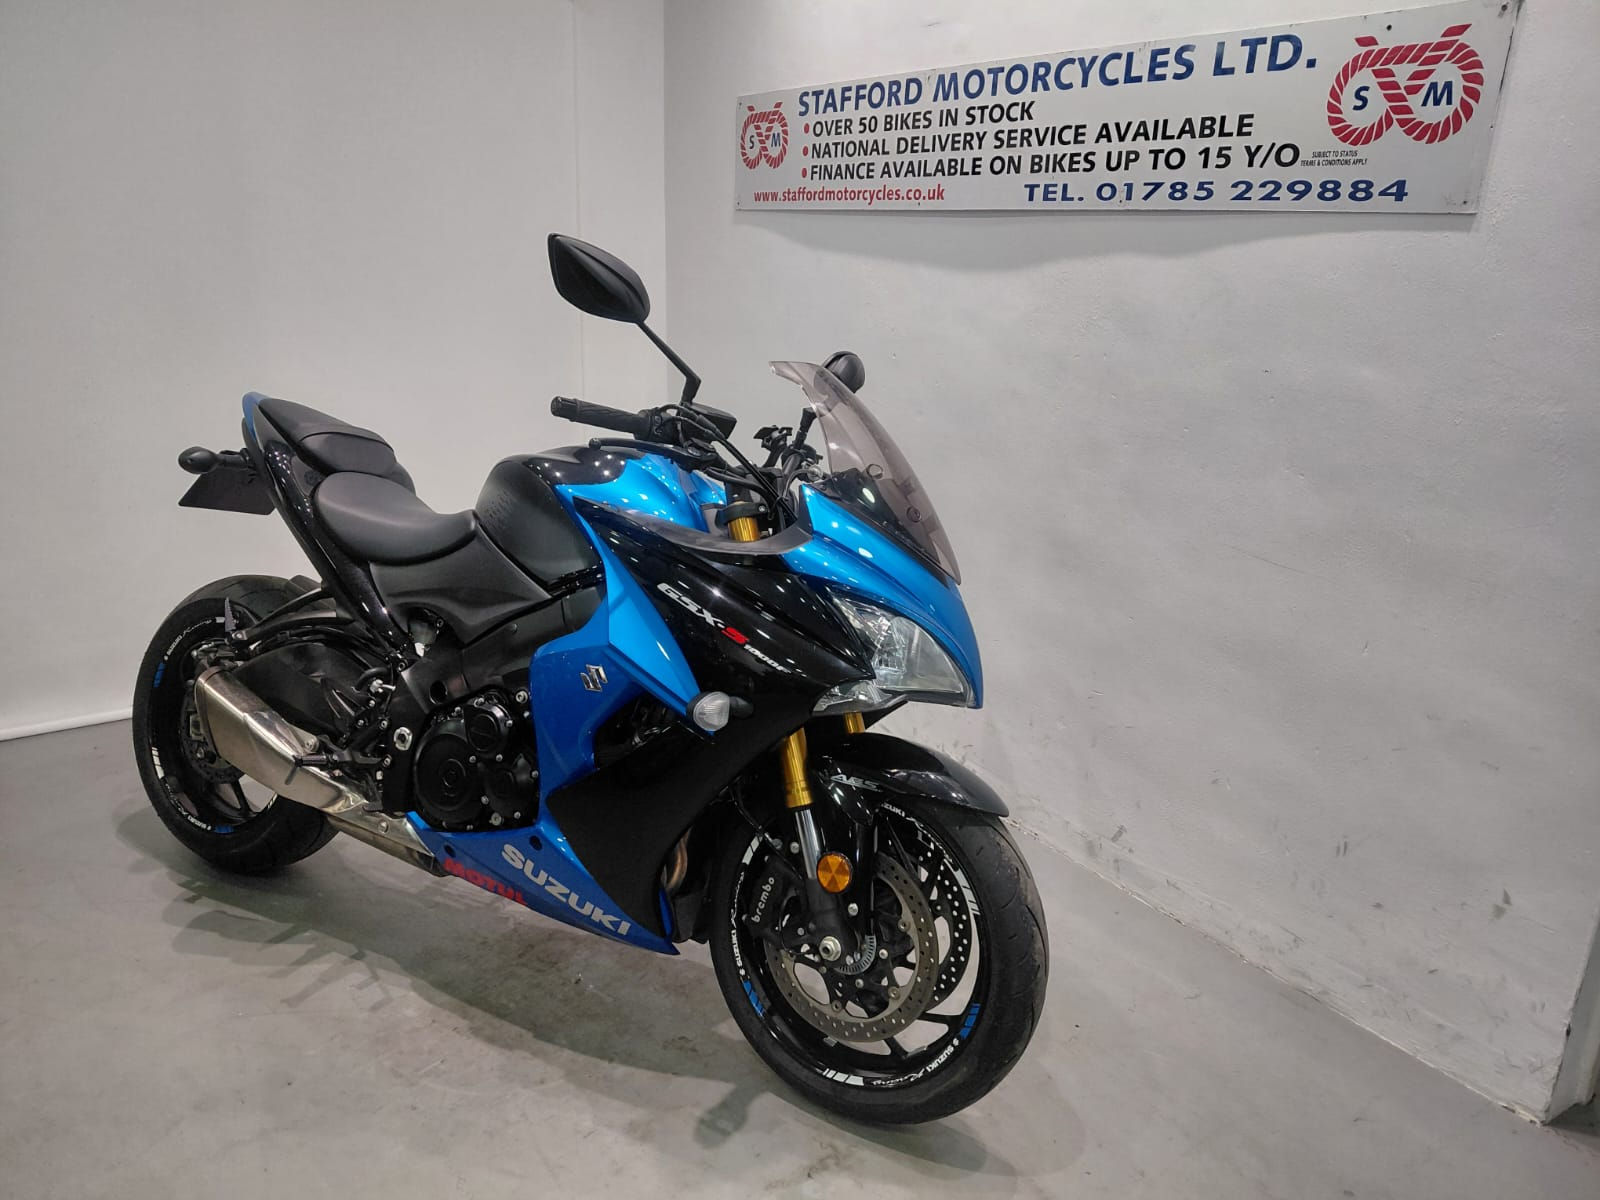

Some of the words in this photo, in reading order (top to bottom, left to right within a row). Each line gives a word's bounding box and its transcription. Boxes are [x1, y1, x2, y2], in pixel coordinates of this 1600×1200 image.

[798, 77, 923, 117] STAFFORD
[932, 44, 1196, 103] MOTORCYCLES
[1212, 33, 1317, 76] LTD.
[1352, 86, 1370, 111] S
[1421, 80, 1453, 107] M
[811, 138, 890, 159] NATIONAL
[896, 131, 987, 155] DELIVERY
[993, 124, 1087, 149] SERVICE
[1094, 113, 1255, 144] AVAILABLE
[812, 118, 853, 137] OVER
[858, 115, 878, 134] 50
[883, 110, 932, 132] BIKES
[938, 107, 959, 127] IN
[965, 100, 1035, 124] STOCK
[810, 162, 875, 181] FINANCE
[880, 157, 982, 179] AVAILABLE
[989, 155, 1021, 175] ON
[1029, 151, 1096, 174] BIKES
[1105, 150, 1140, 172] UP
[1148, 147, 1186, 170] TO
[1198, 146, 1232, 169] 15
[1245, 142, 1300, 168] Y/O
[1332, 150, 1339, 158] TO
[753, 183, 945, 206] www.staffordmotorcycles.co.uk
[1023, 183, 1084, 202] TEL.
[1095, 180, 1214, 202] 01785
[1229, 179, 1408, 202] 229884
[443, 858, 529, 906] MOTUL
[502, 843, 632, 936] SUZUKI
[751, 876, 775, 923] brembo
